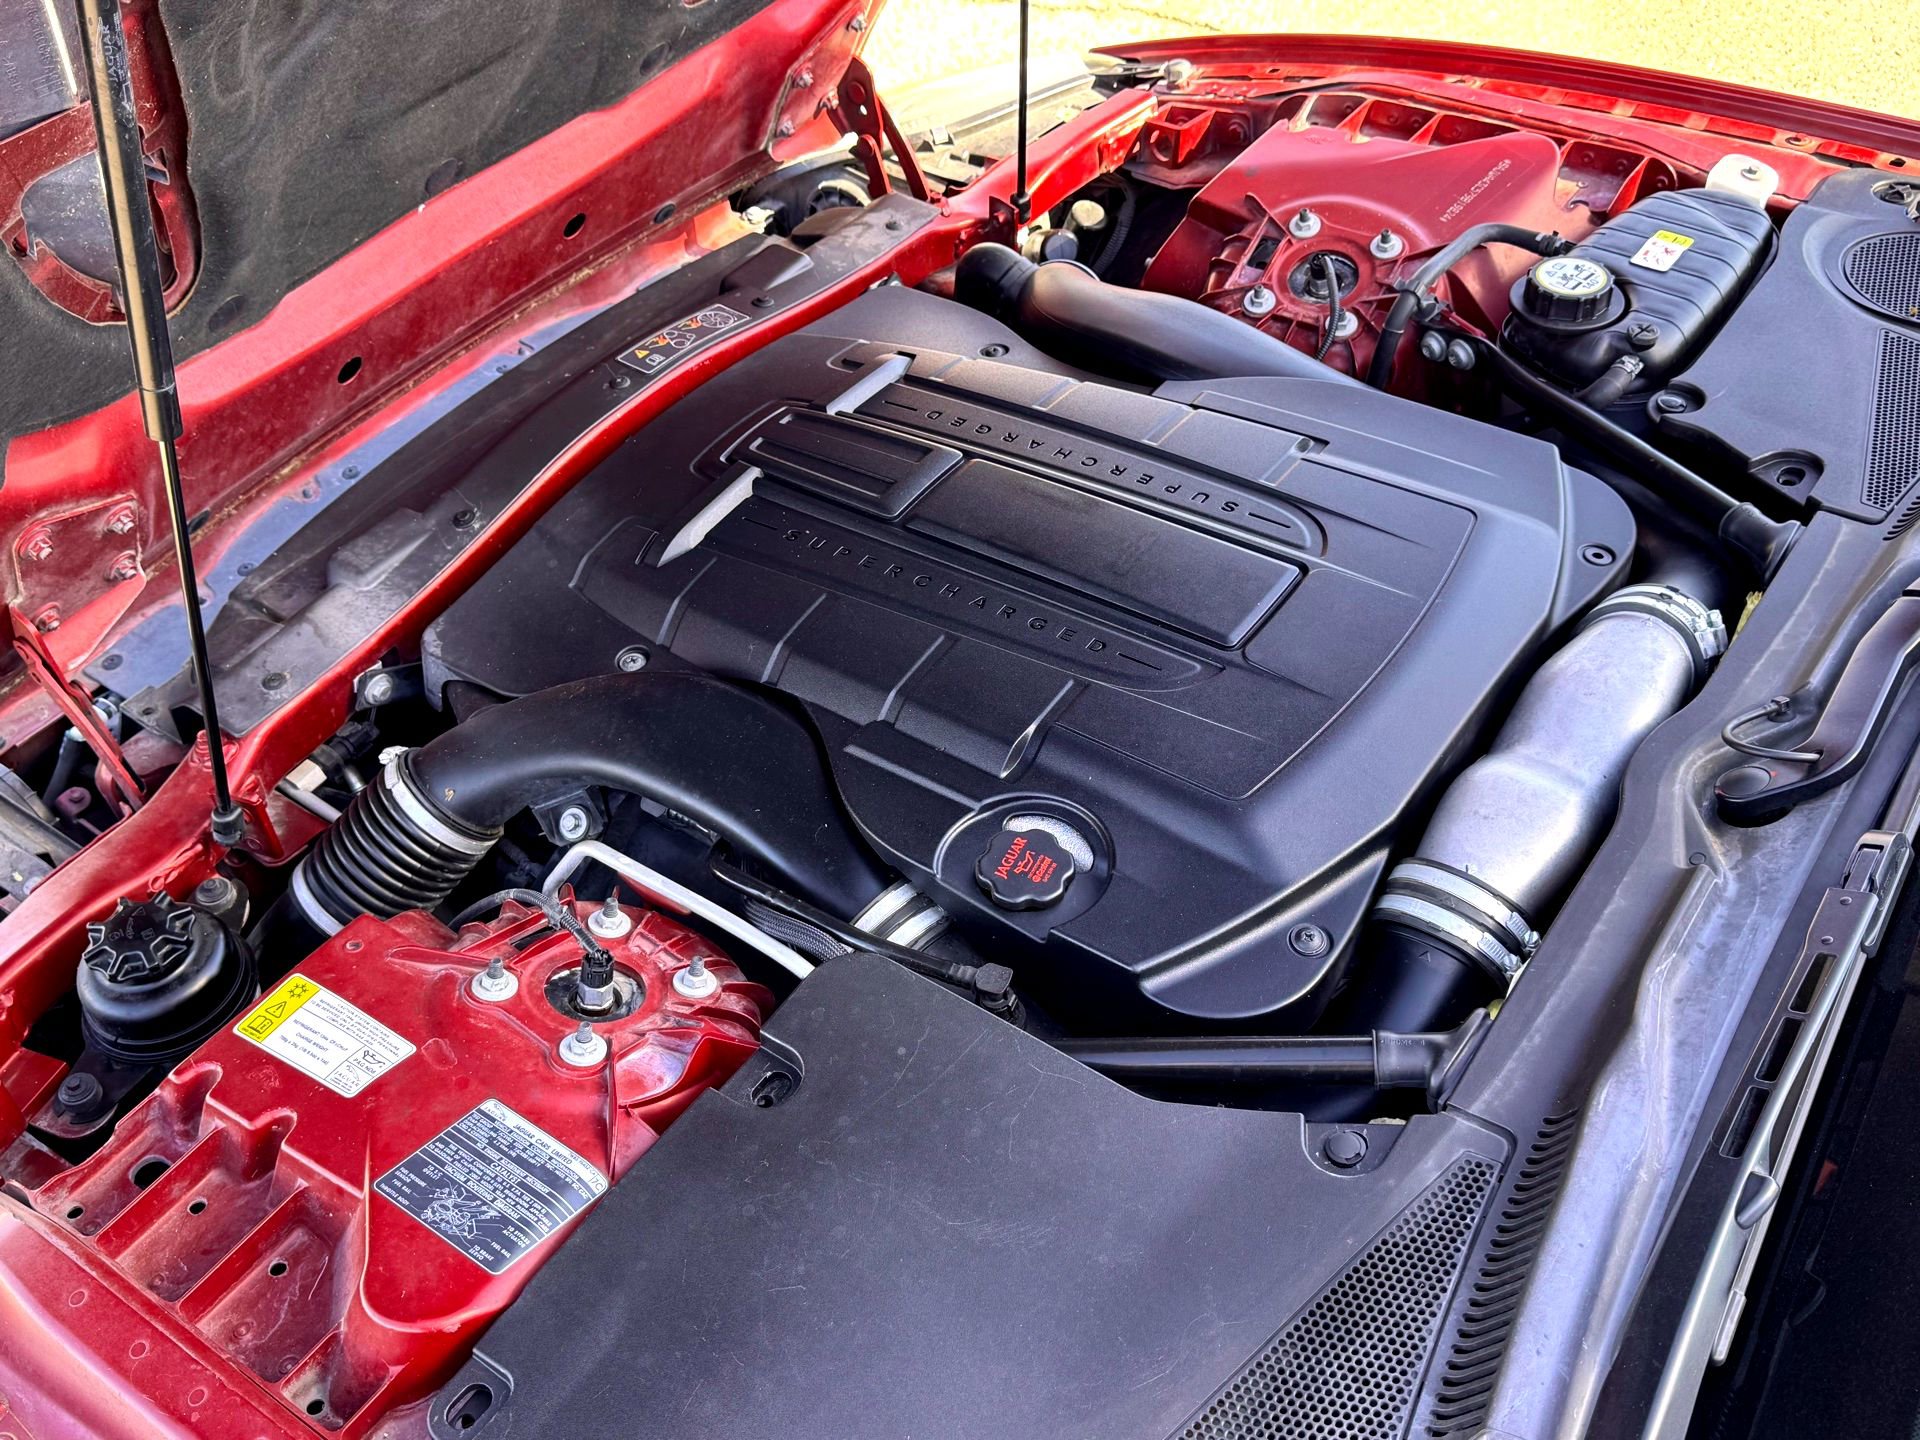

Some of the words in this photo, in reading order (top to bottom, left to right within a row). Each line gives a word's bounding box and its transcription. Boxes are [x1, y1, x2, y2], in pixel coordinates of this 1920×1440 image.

[103, 25, 118, 82] JAGUAR
[925, 410, 1239, 513] SUPERCHARGED
[783, 529, 1106, 653] SUPERCHARGED
[994, 837, 1027, 879] JAGUAR
[511, 1122, 536, 1141] JAGUAR
[533, 1137, 552, 1151] CARS
[548, 1147, 574, 1166] LIMITED
[488, 1161, 521, 1185] CATALYST
[378, 1182, 400, 1198] THROTTLE
[441, 1163, 468, 1182] VACUUM
[465, 1179, 495, 1201] ROUTEING
[492, 1198, 521, 1220] DIAGRAM
[587, 1176, 607, 1192] 7C
[534, 1220, 551, 1233] CARS
[489, 1240, 503, 1251] FUEL
[500, 1228, 527, 1248] ACTUATOR
[511, 1229, 532, 1245] BYPASS
[467, 1247, 485, 1261] SERVO
[477, 1248, 495, 1261] BRAKE
